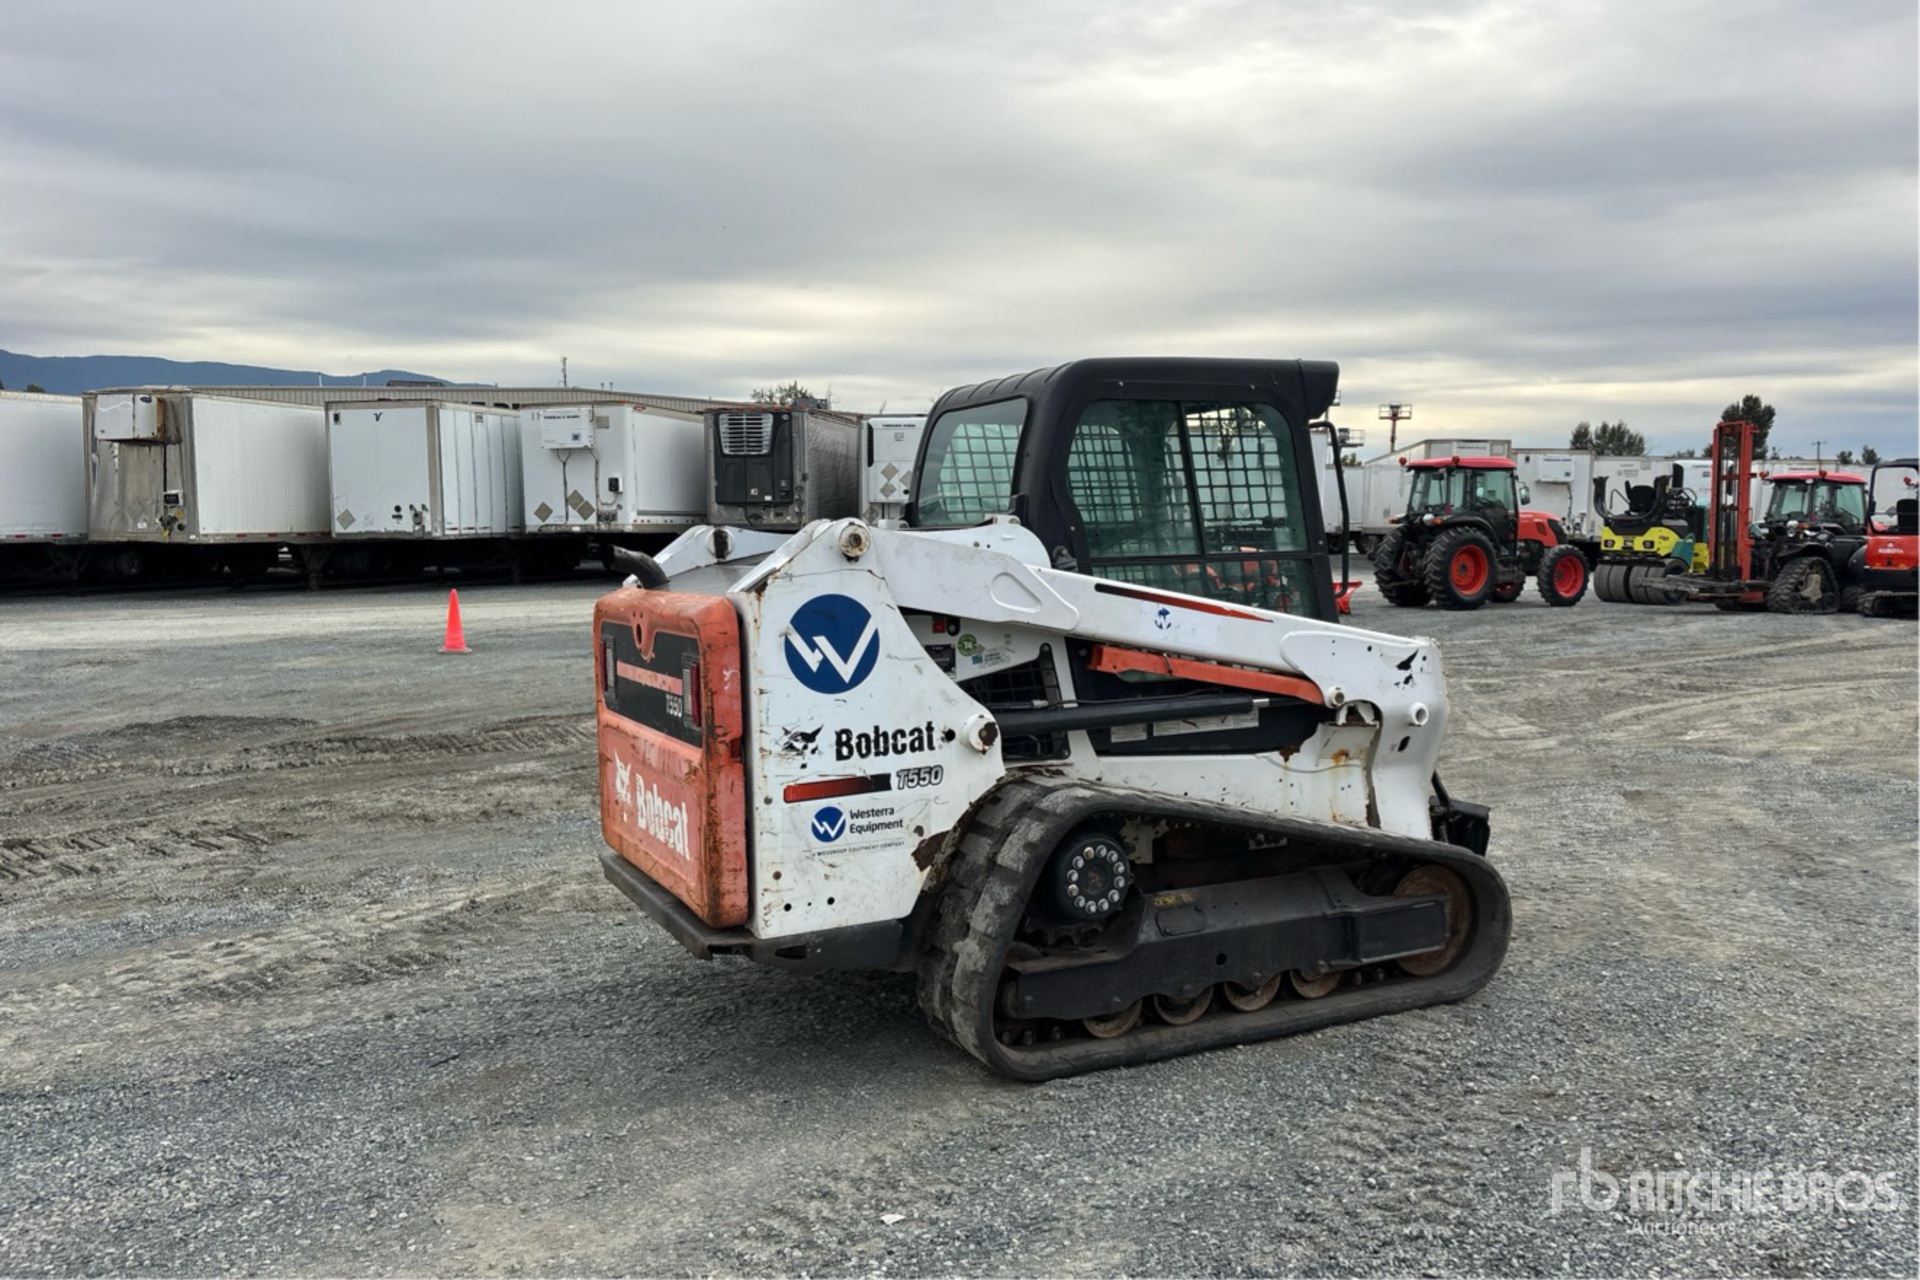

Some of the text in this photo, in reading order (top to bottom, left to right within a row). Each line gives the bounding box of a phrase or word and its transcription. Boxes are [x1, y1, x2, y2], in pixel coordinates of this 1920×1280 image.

[665, 693, 683, 718] T550
[835, 720, 935, 761] Bobcat
[896, 764, 944, 790] T550
[635, 772, 690, 861] Bobcat
[849, 807, 895, 819] Westerra
[849, 820, 904, 834] Equipment
[849, 844, 879, 852] EQUIPMENT
